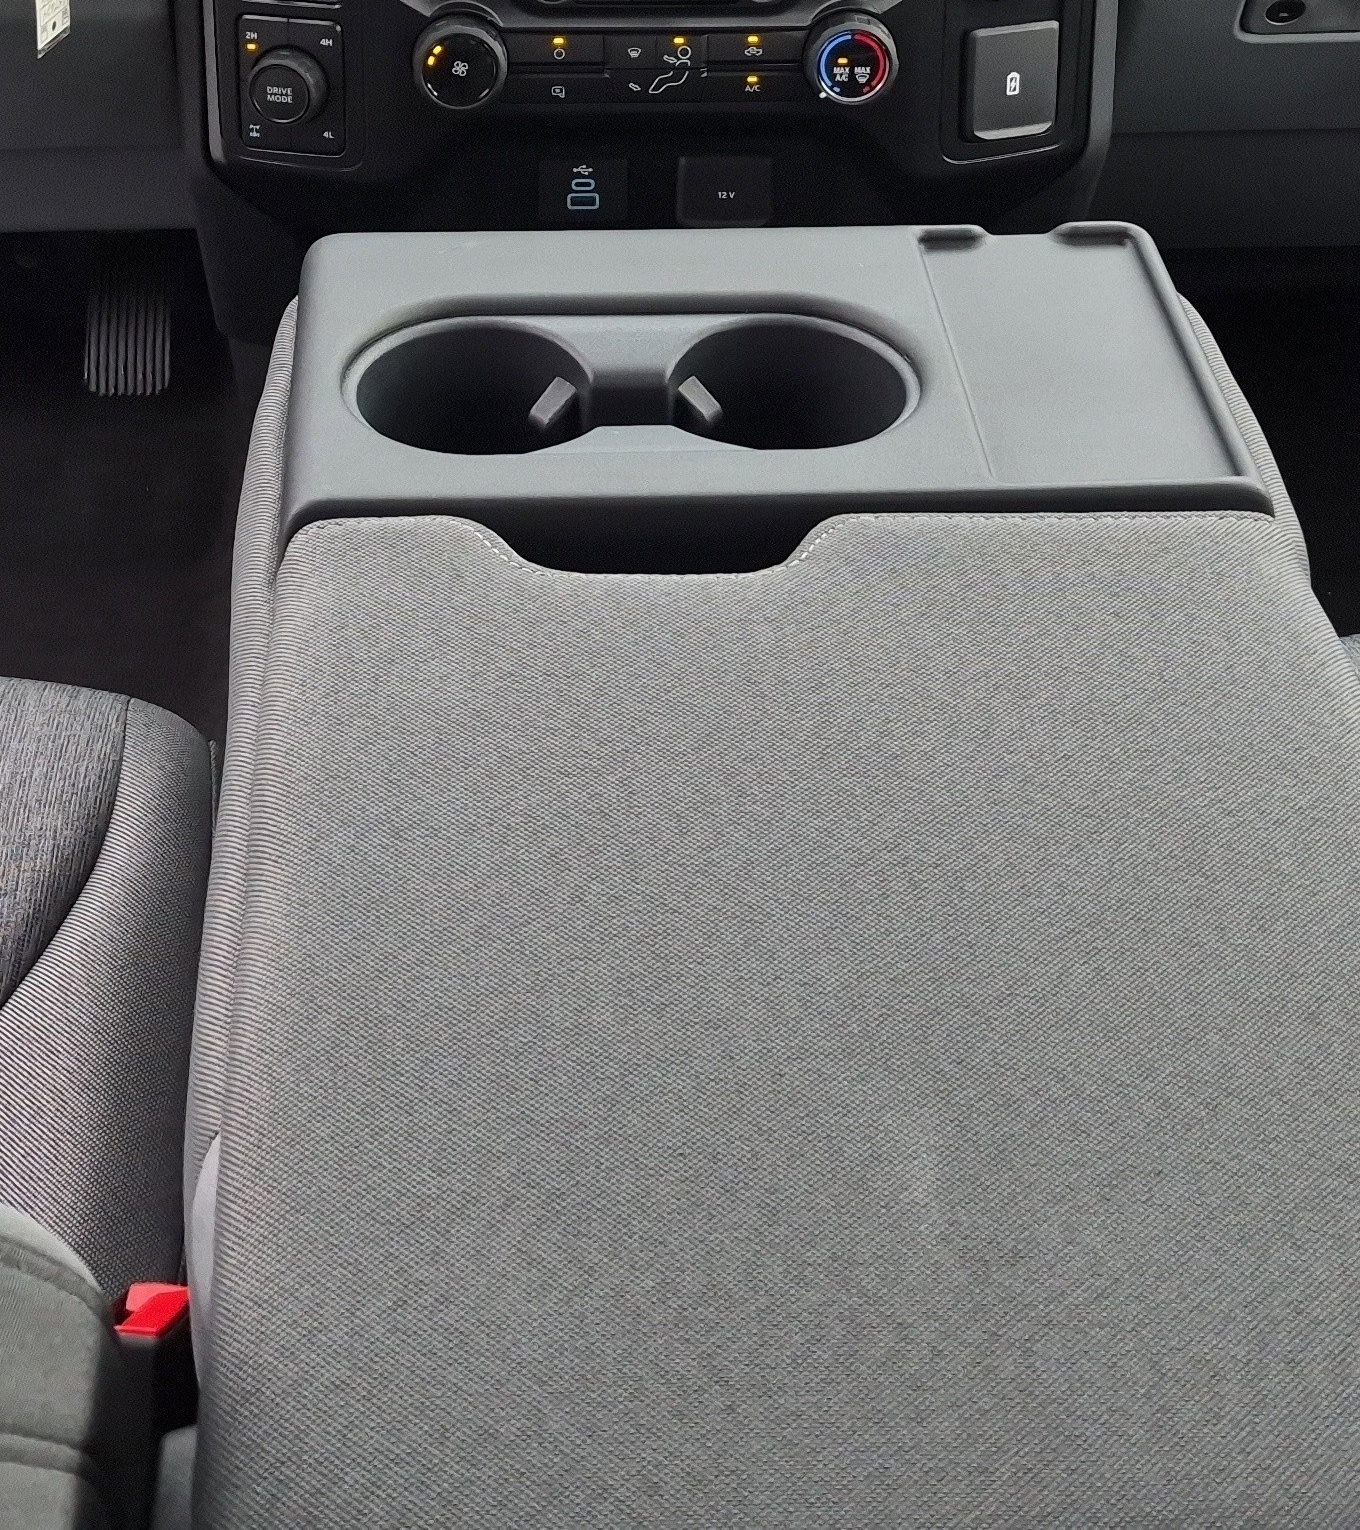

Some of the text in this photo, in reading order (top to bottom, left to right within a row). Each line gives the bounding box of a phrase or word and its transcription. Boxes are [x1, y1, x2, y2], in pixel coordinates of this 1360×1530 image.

[245, 31, 258, 40] 2H
[320, 38, 333, 46] 4H
[266, 86, 293, 95] DRIVE
[745, 84, 761, 92] A/C
[266, 94, 293, 103] MODE
[323, 131, 334, 139] 4L
[718, 191, 727, 199] 12
